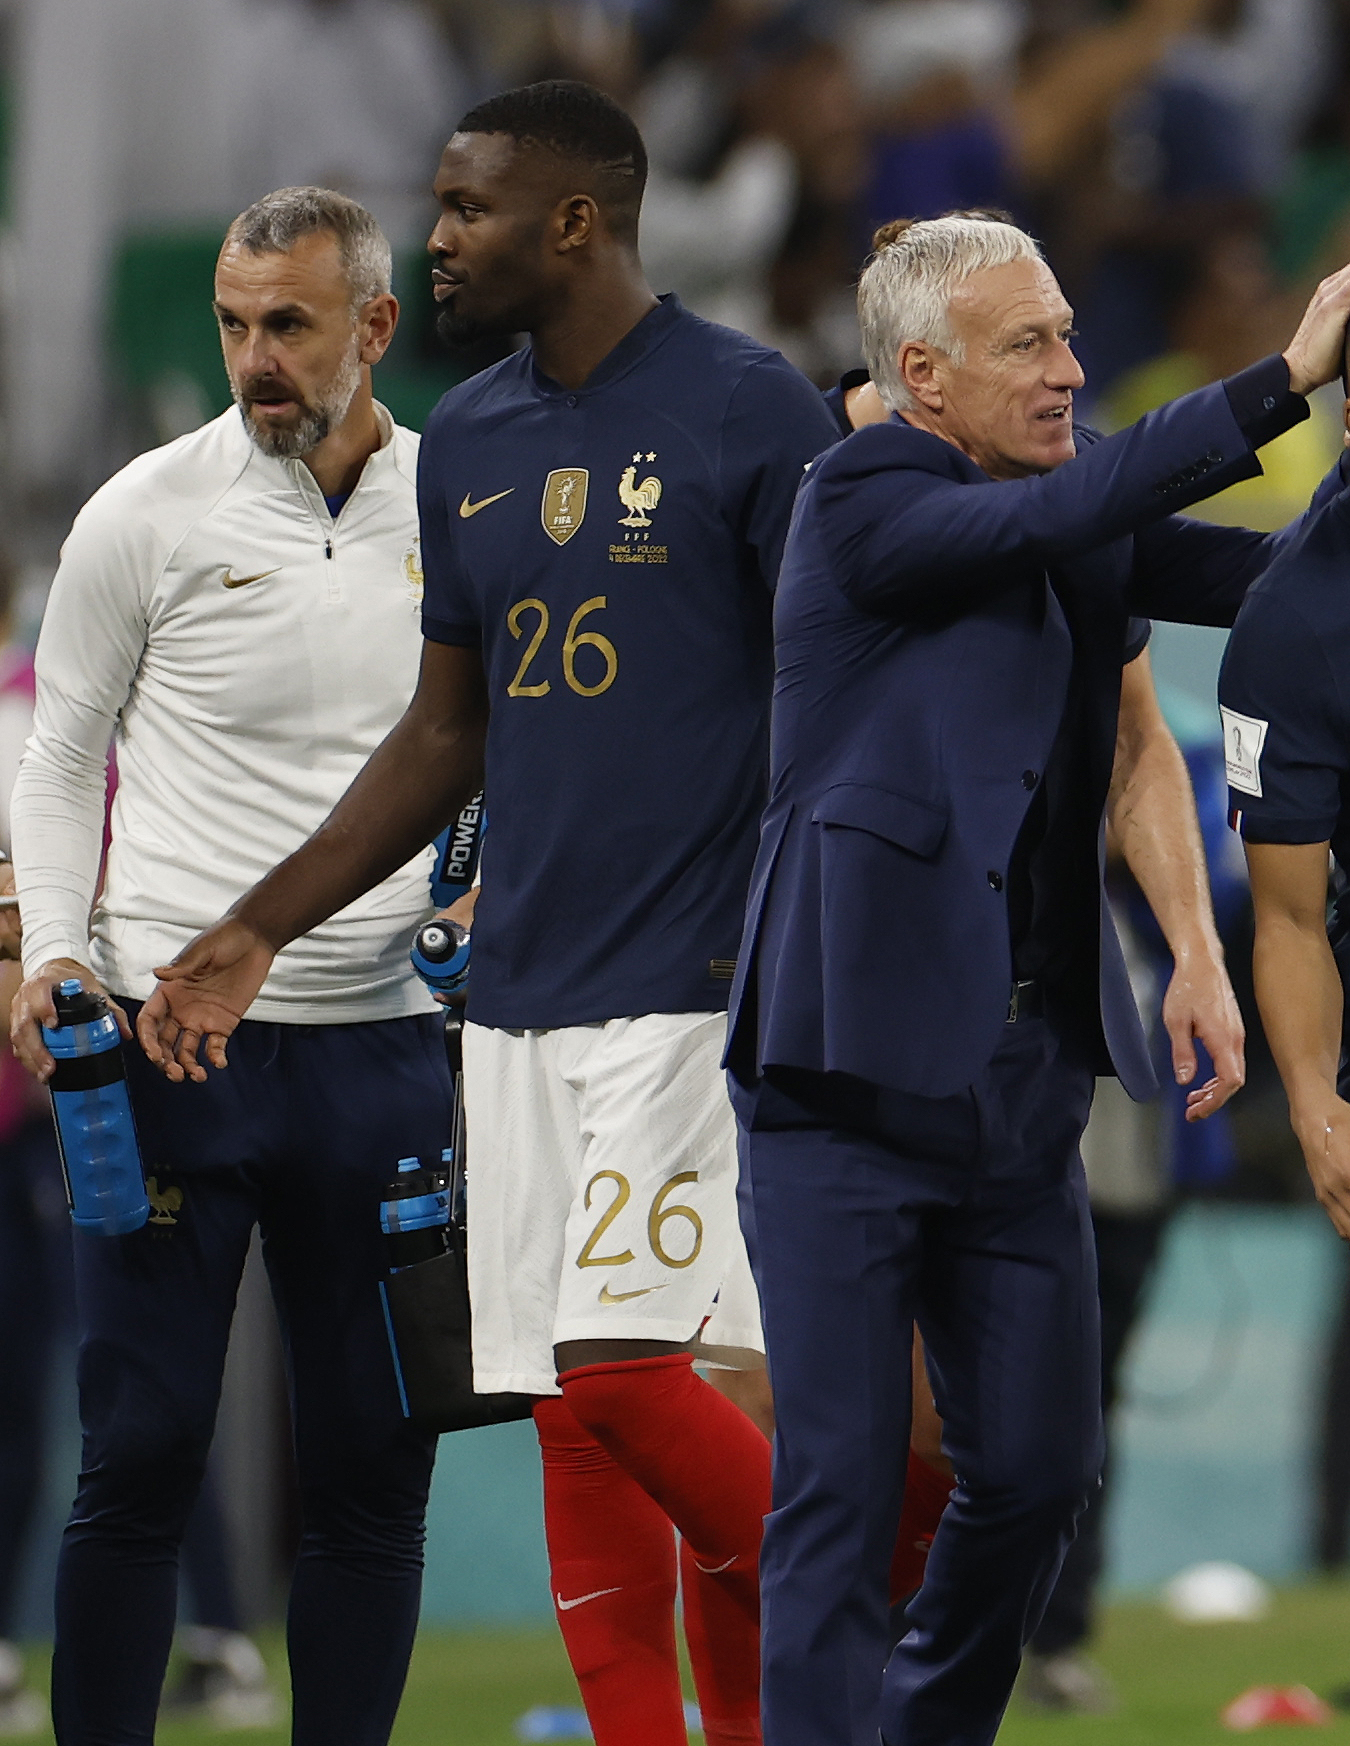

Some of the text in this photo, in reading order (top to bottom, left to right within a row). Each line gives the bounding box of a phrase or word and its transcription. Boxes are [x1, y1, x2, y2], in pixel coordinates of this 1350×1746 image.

[553, 516, 572, 525] FIFA
[507, 596, 618, 698] 26
[577, 1169, 704, 1269] 26
